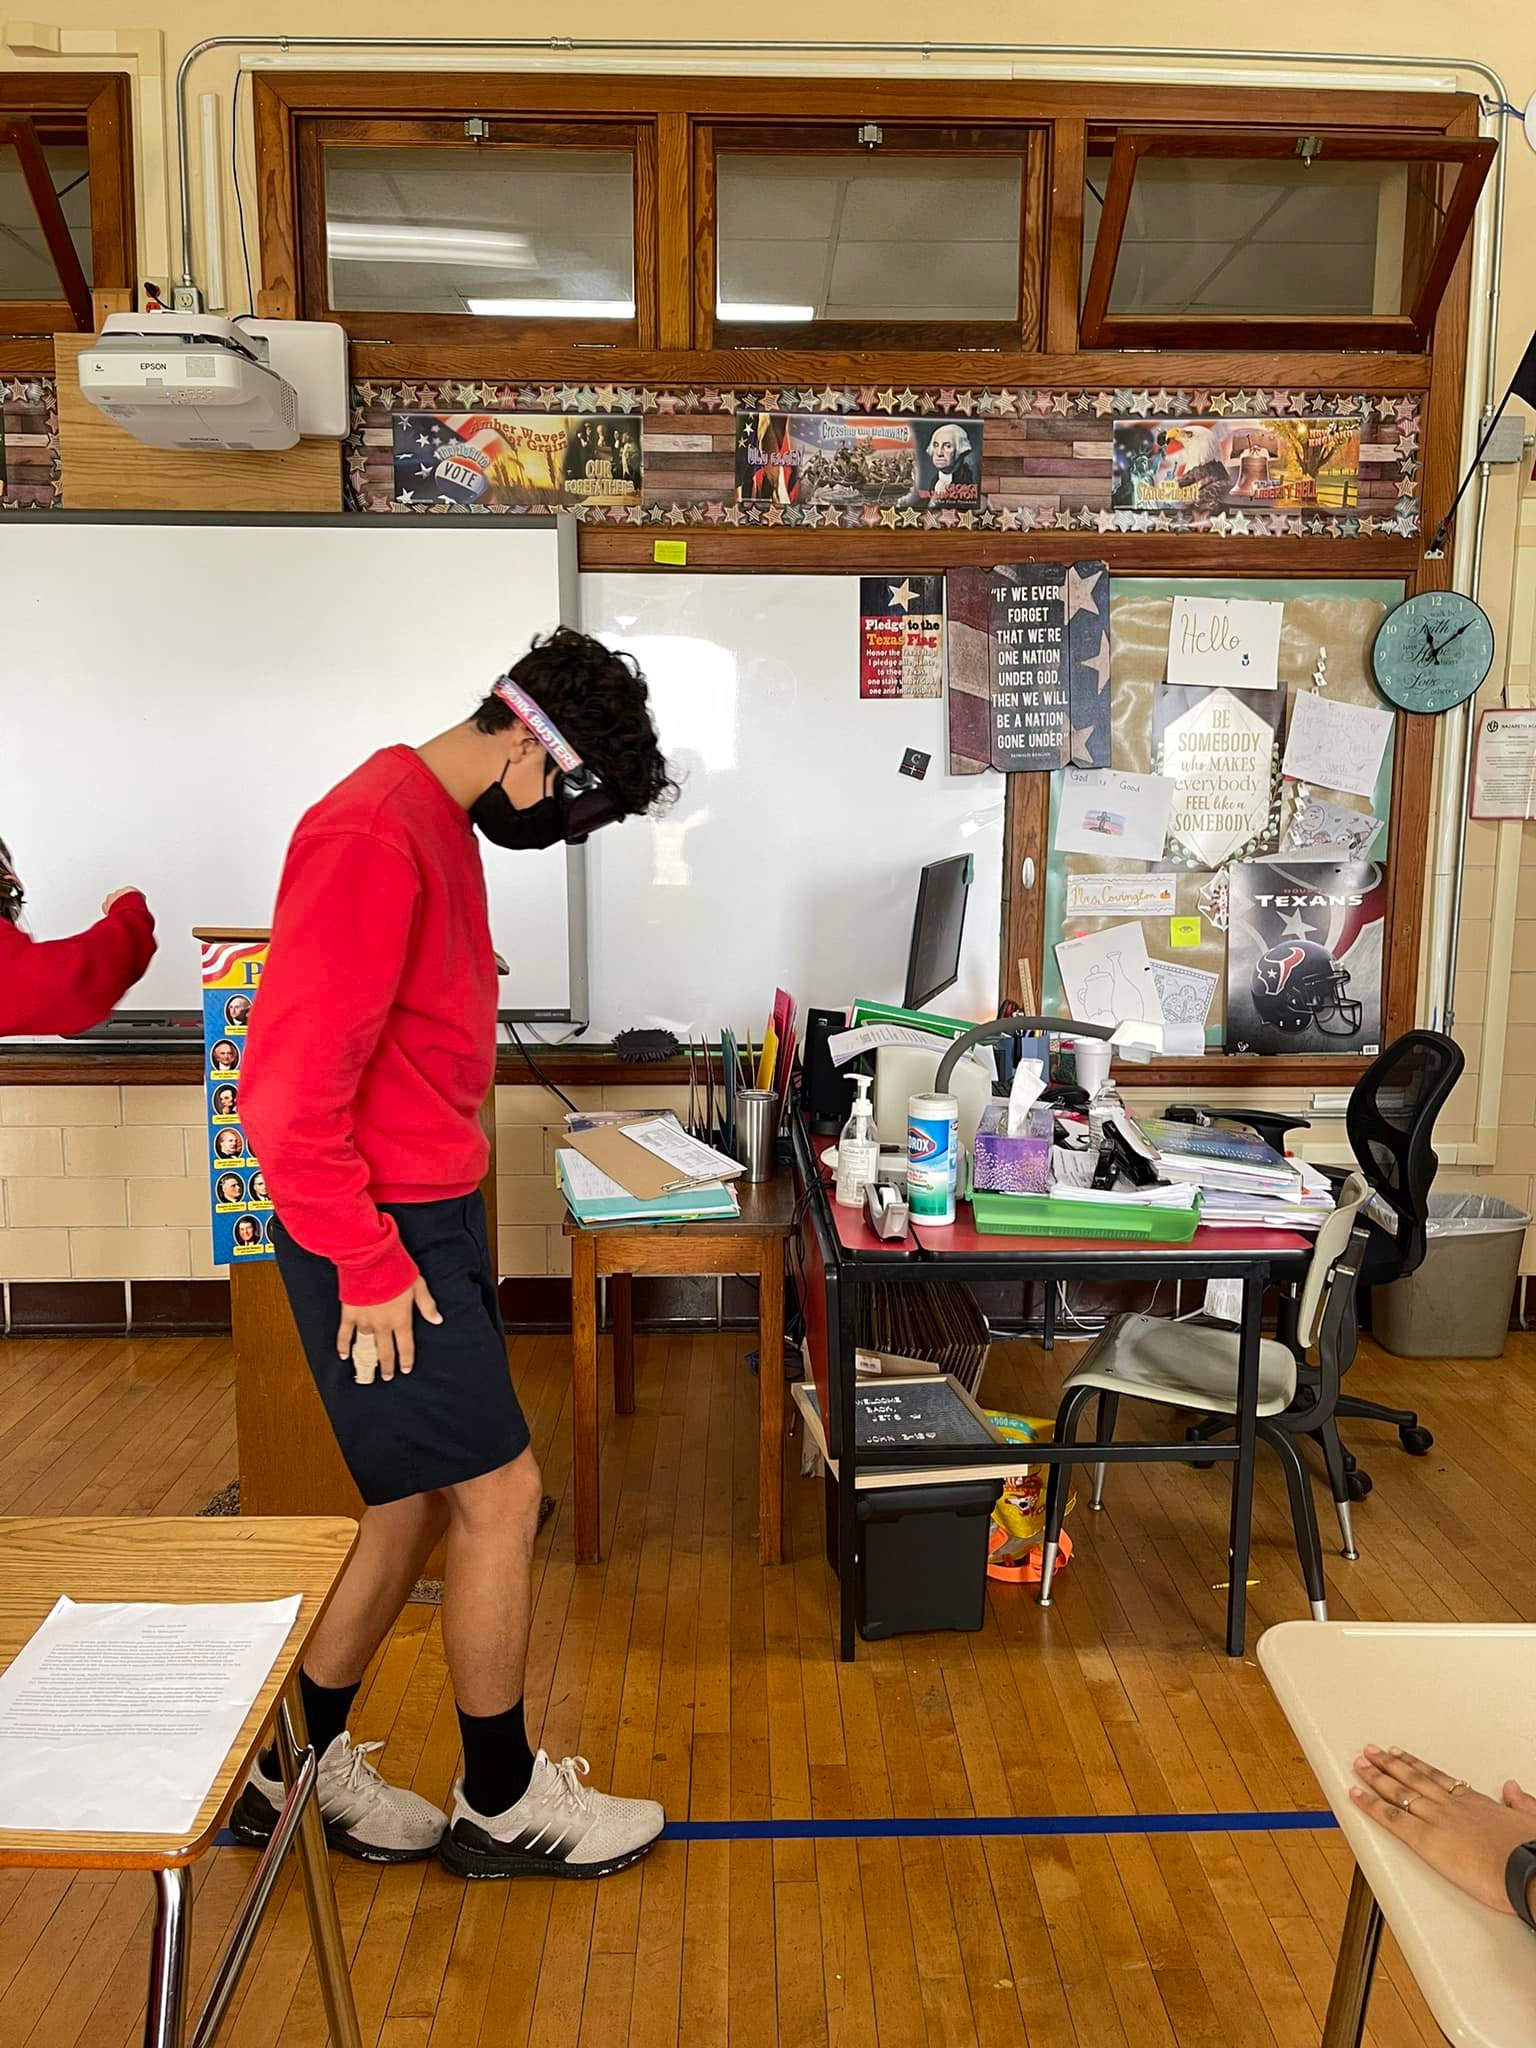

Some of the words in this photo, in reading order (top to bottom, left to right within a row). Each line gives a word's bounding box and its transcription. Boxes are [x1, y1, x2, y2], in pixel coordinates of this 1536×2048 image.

[471, 419, 517, 435] Amber
[520, 426, 567, 442] Waves
[821, 419, 857, 439] Crossing
[507, 435, 524, 448] of
[527, 440, 569, 453] Grain
[443, 462, 478, 487] VOTE
[585, 459, 614, 479] OUR
[565, 478, 635, 496] FOREFATHERS
[945, 483, 977, 491] GEORGE
[1254, 482, 1293, 499] LIBERTY
[1295, 480, 1316, 498] BELL
[1011, 586, 1028, 601] WE
[1031, 585, 1060, 600] EVER
[1431, 596, 1442, 606] 12
[1008, 607, 1049, 623] FORGET
[1406, 605, 1415, 615] 11
[1459, 602, 1463, 612] 1
[865, 619, 905, 632] Pledge
[907, 620, 919, 630] to
[920, 619, 940, 630] the
[1386, 624, 1397, 634] 10
[1474, 619, 1481, 629] 2
[866, 633, 905, 646] Texas
[907, 633, 937, 648] Flag
[996, 629, 1024, 644] THAT
[1028, 627, 1062, 643] WE'RE
[1181, 613, 1241, 655] Hello
[998, 650, 1019, 665] ONE
[1022, 648, 1060, 664] NATION
[1380, 651, 1386, 661] 9
[1481, 644, 1487, 655] 3
[872, 659, 897, 668] pledge
[998, 671, 1033, 686] UNDER
[1385, 675, 1392, 685] 8
[1472, 670, 1478, 680] 4
[991, 692, 1019, 707] THEN
[1022, 691, 1039, 706] WE
[1043, 690, 1069, 705] WILL
[1402, 692, 1409, 702] 7
[1453, 689, 1459, 699] 5
[1427, 698, 1434, 707] 6
[997, 714, 1010, 728] BE
[1014, 713, 1022, 727] A
[1025, 711, 1064, 727] NATION
[1212, 709, 1231, 728] BE
[529, 715, 579, 770] BUSTERS
[997, 734, 1025, 749] GONE
[1028, 732, 1069, 748] UNDER"
[1178, 733, 1261, 752] SOMEBODY
[1181, 754, 1205, 773] who
[1209, 756, 1256, 772] MAKES
[1071, 769, 1089, 782] God
[1120, 780, 1141, 792] Good
[1175, 775, 1258, 796] everybody
[1186, 795, 1210, 810] FEEL
[1213, 794, 1236, 810] like
[1236, 801, 1246, 810] a
[1071, 885, 1101, 905] Mrs.
[1102, 885, 1157, 905] Covington
[1254, 894, 1364, 908] TEXANS
[855, 1396, 902, 1406] WELCOME
